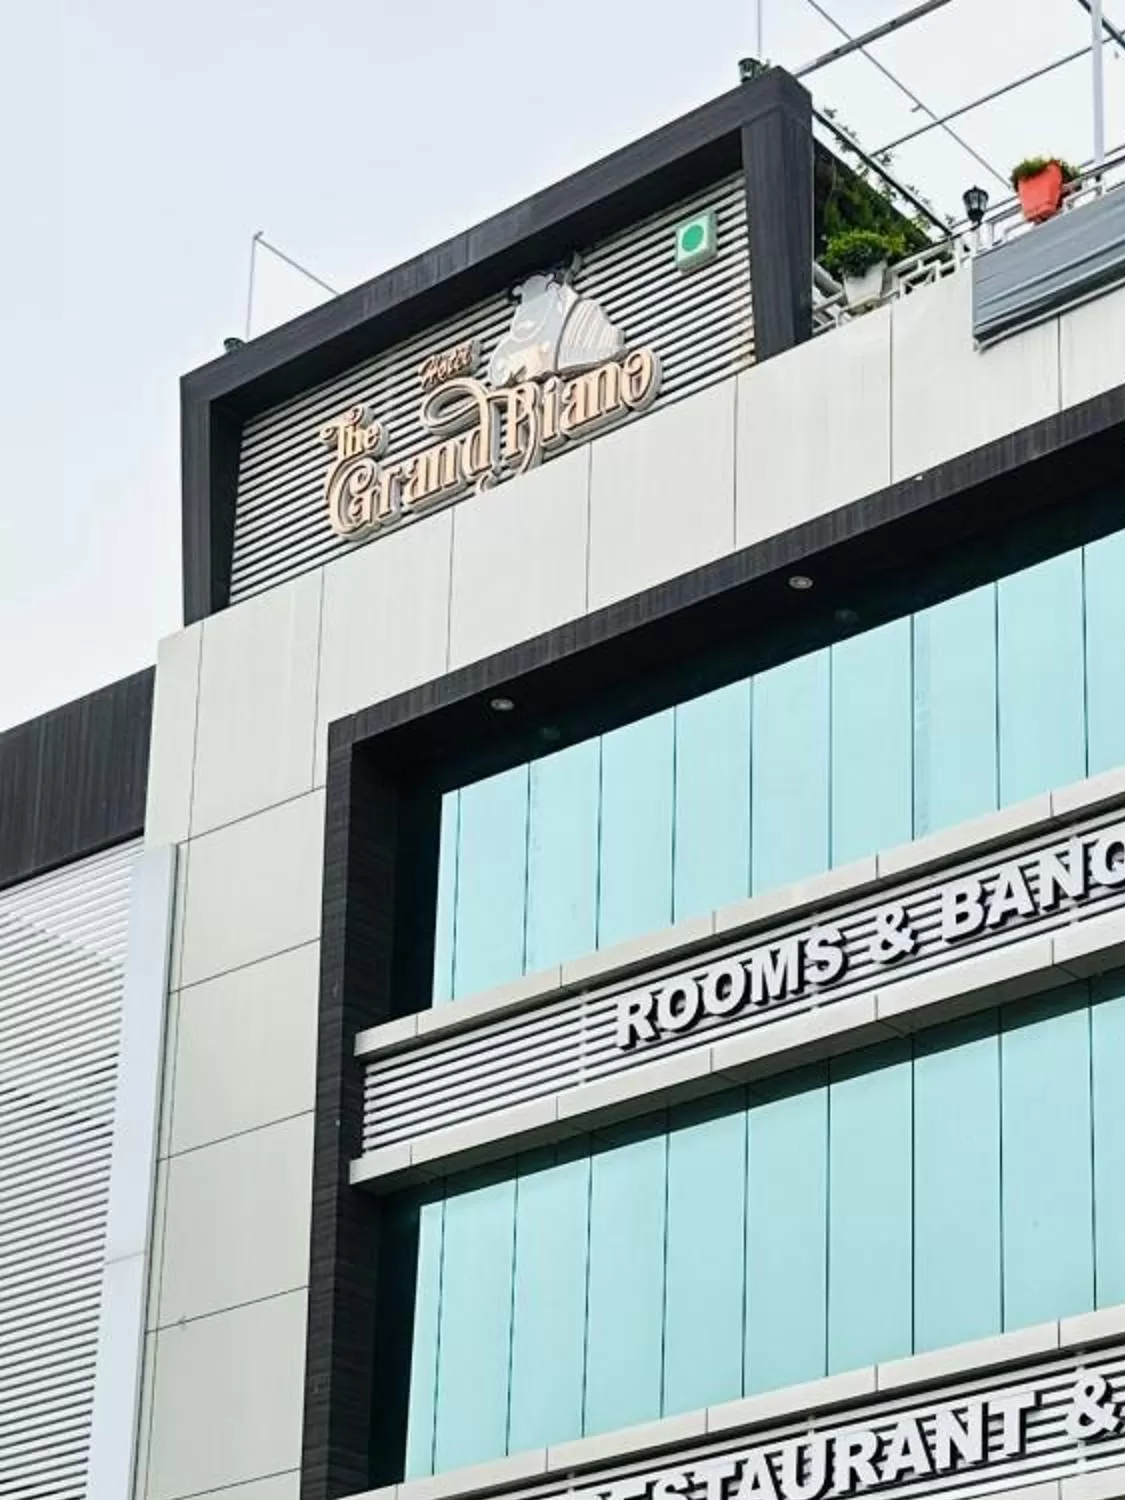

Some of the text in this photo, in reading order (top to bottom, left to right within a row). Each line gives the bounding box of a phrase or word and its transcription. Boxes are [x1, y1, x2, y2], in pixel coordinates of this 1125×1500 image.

[320, 405, 387, 459] The
[325, 348, 662, 541] Grand Piano
[613, 928, 847, 1049] ROOMS
[873, 905, 919, 965] &
[1066, 1374, 1123, 1440] &
